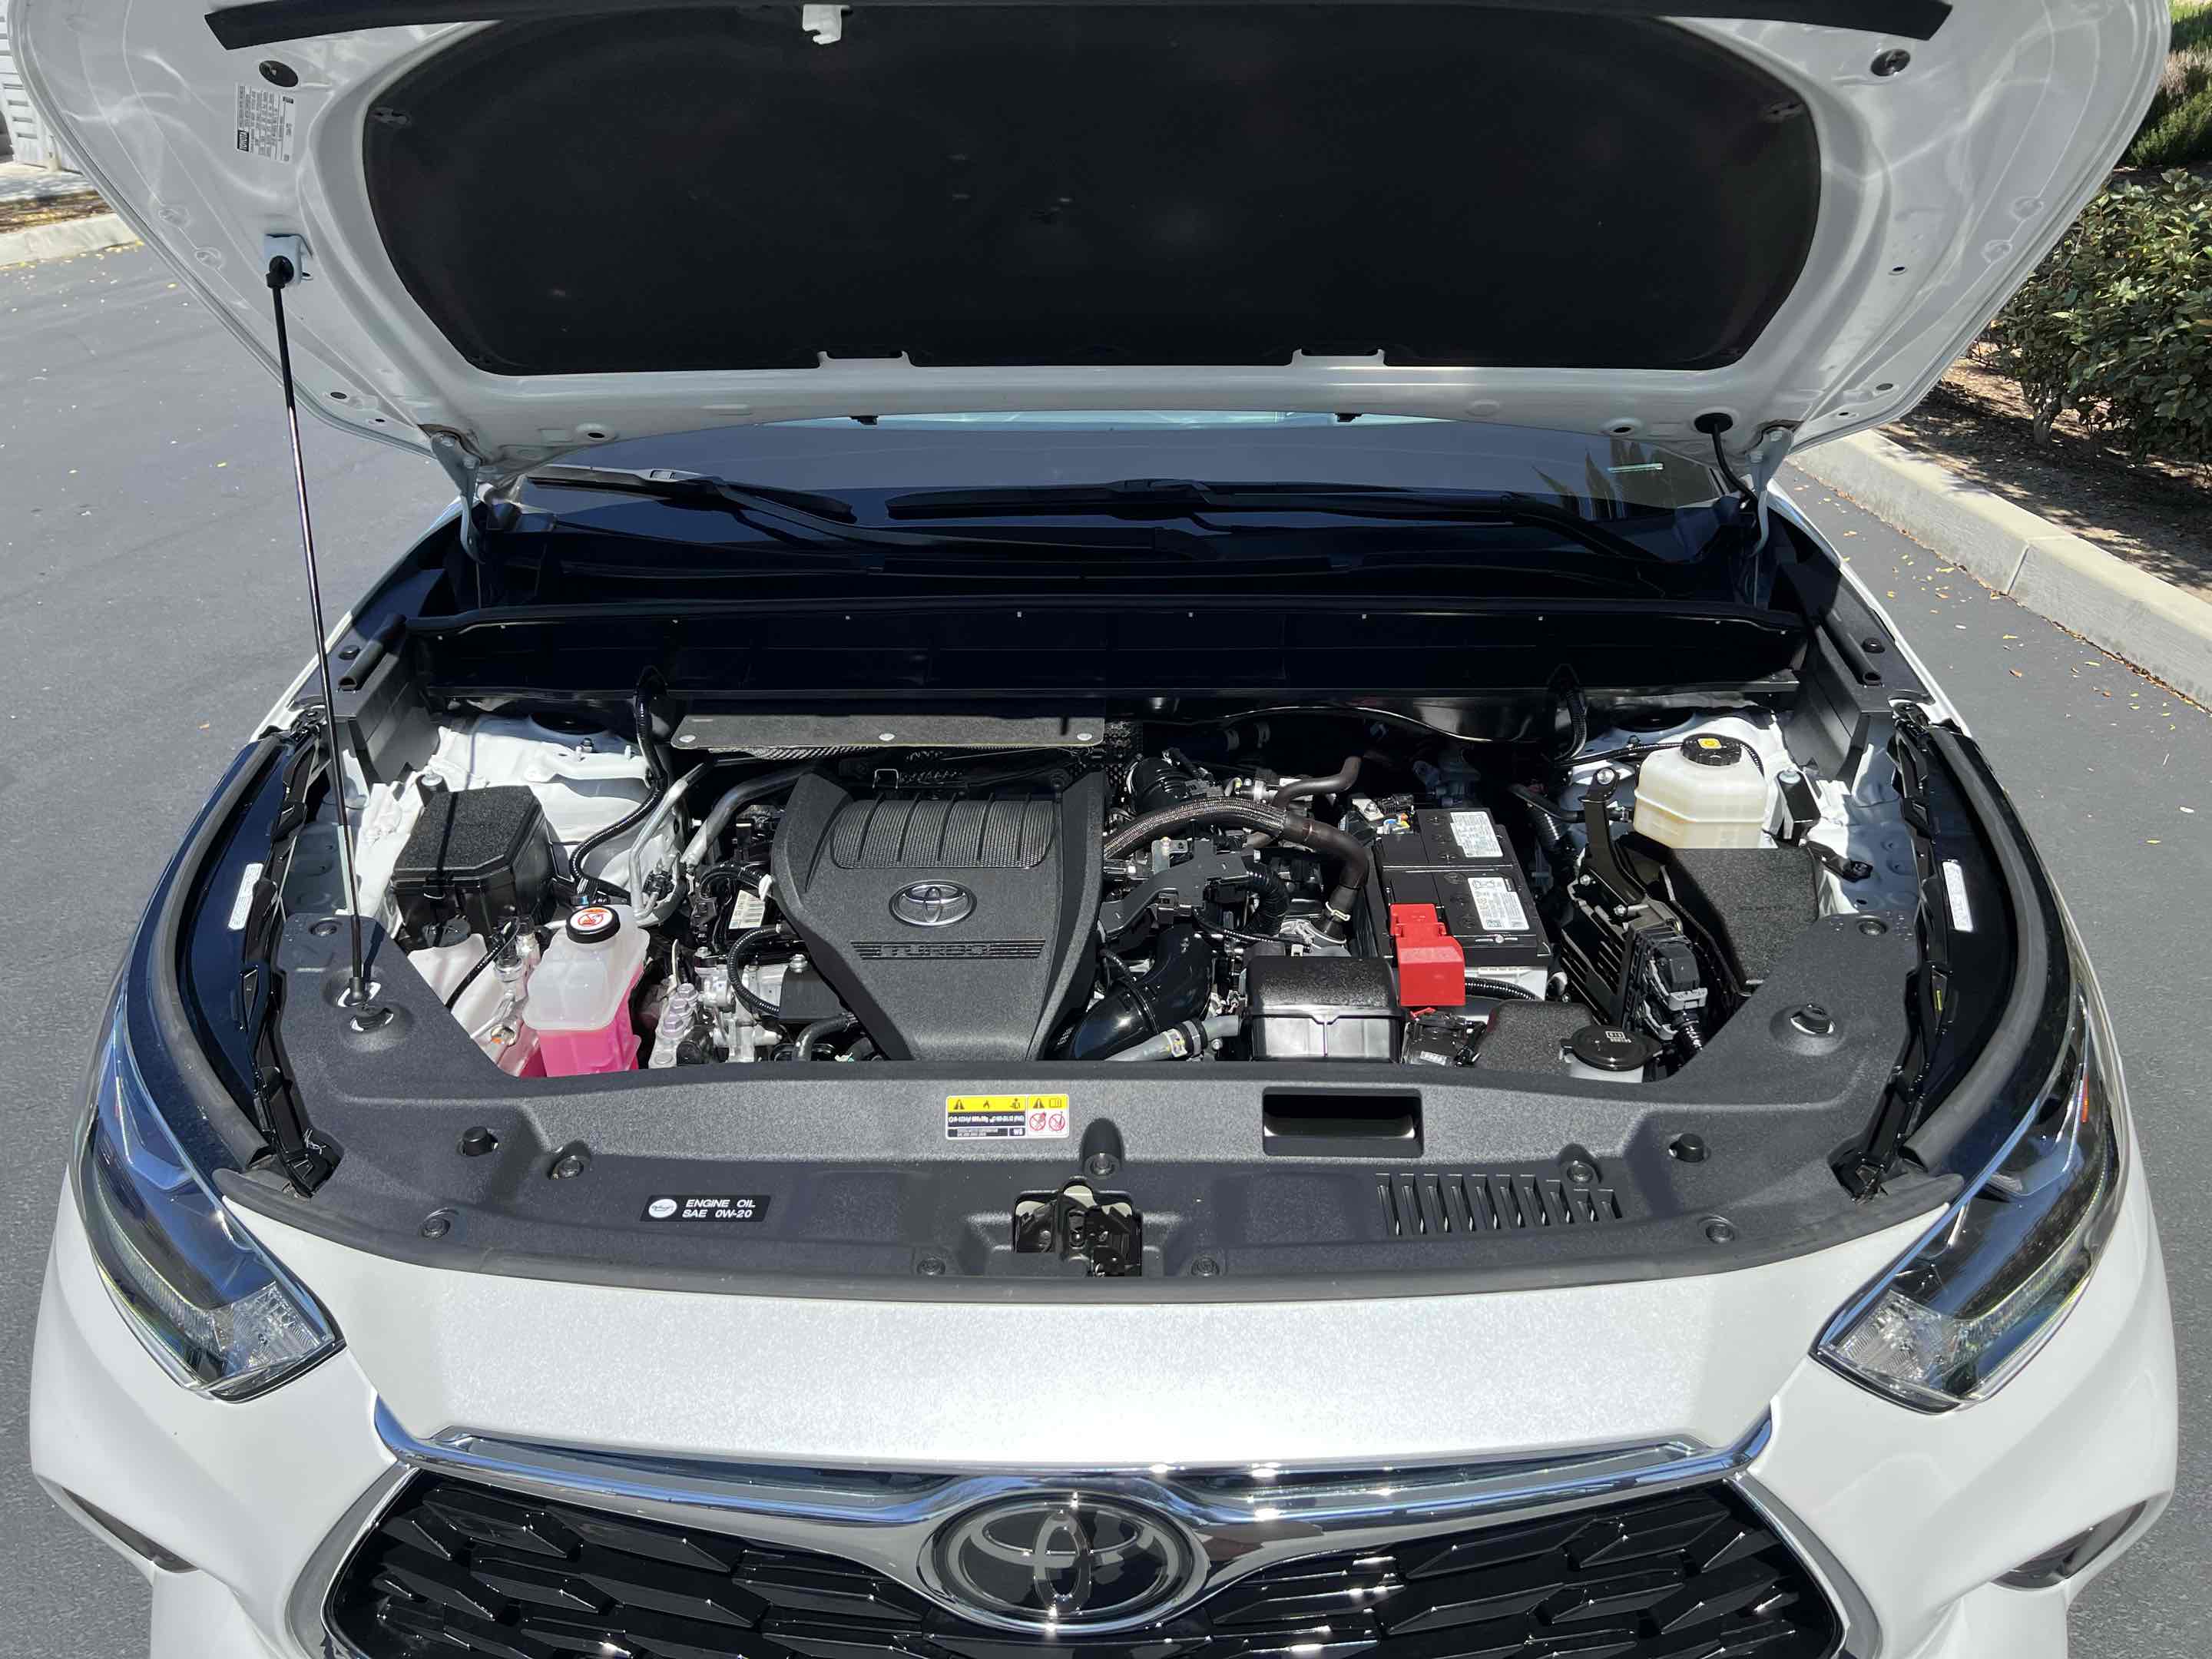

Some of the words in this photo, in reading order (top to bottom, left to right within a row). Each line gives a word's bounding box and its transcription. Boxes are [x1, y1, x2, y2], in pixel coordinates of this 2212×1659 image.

[239, 129, 247, 150] TOYOTA
[686, 1199, 730, 1208] ENGINE
[737, 1199, 757, 1208] OIL
[682, 1209, 707, 1218] SAE
[715, 1209, 753, 1218] 0W-20
